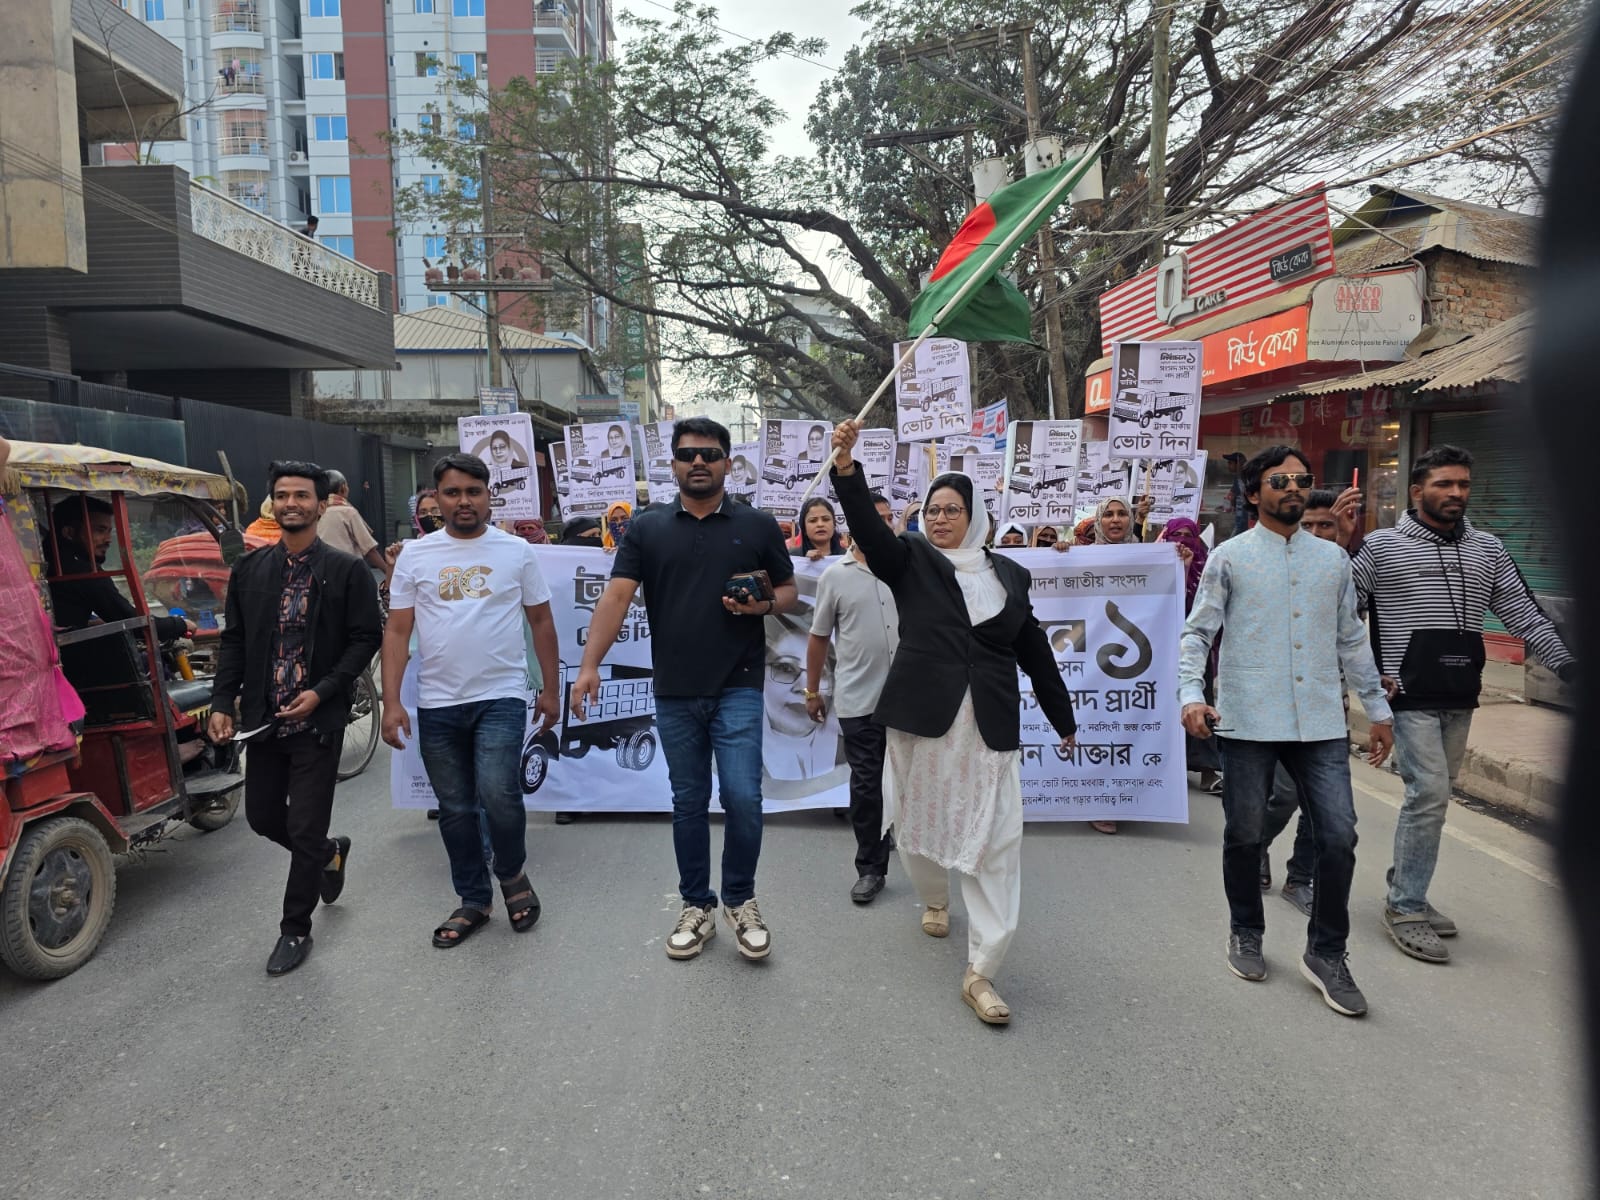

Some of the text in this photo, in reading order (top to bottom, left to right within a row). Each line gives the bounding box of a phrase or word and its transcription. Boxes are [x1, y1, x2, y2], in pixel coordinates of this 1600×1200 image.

[1195, 290, 1227, 311] CAKE
[1336, 299, 1380, 311] TIGER
[1258, 328, 1298, 366] কেক
[1121, 368, 1136, 379] ১২
[902, 413, 934, 435] ভোট
[938, 411, 967, 430] দিন
[1113, 431, 1192, 451] ভোট দিন
[1009, 501, 1041, 519] ভোট
[1046, 500, 1073, 519] দিন
[1063, 571, 1105, 589] জাতীয়
[1109, 574, 1148, 588] সংসদ
[1096, 600, 1152, 679] ১
[1104, 681, 1157, 712] প্রার্থী
[1088, 720, 1120, 732] নরসিংদী
[1141, 719, 1162, 732] কোর্ট
[1051, 741, 1134, 767] আক্তার
[1142, 752, 1163, 767] কে
